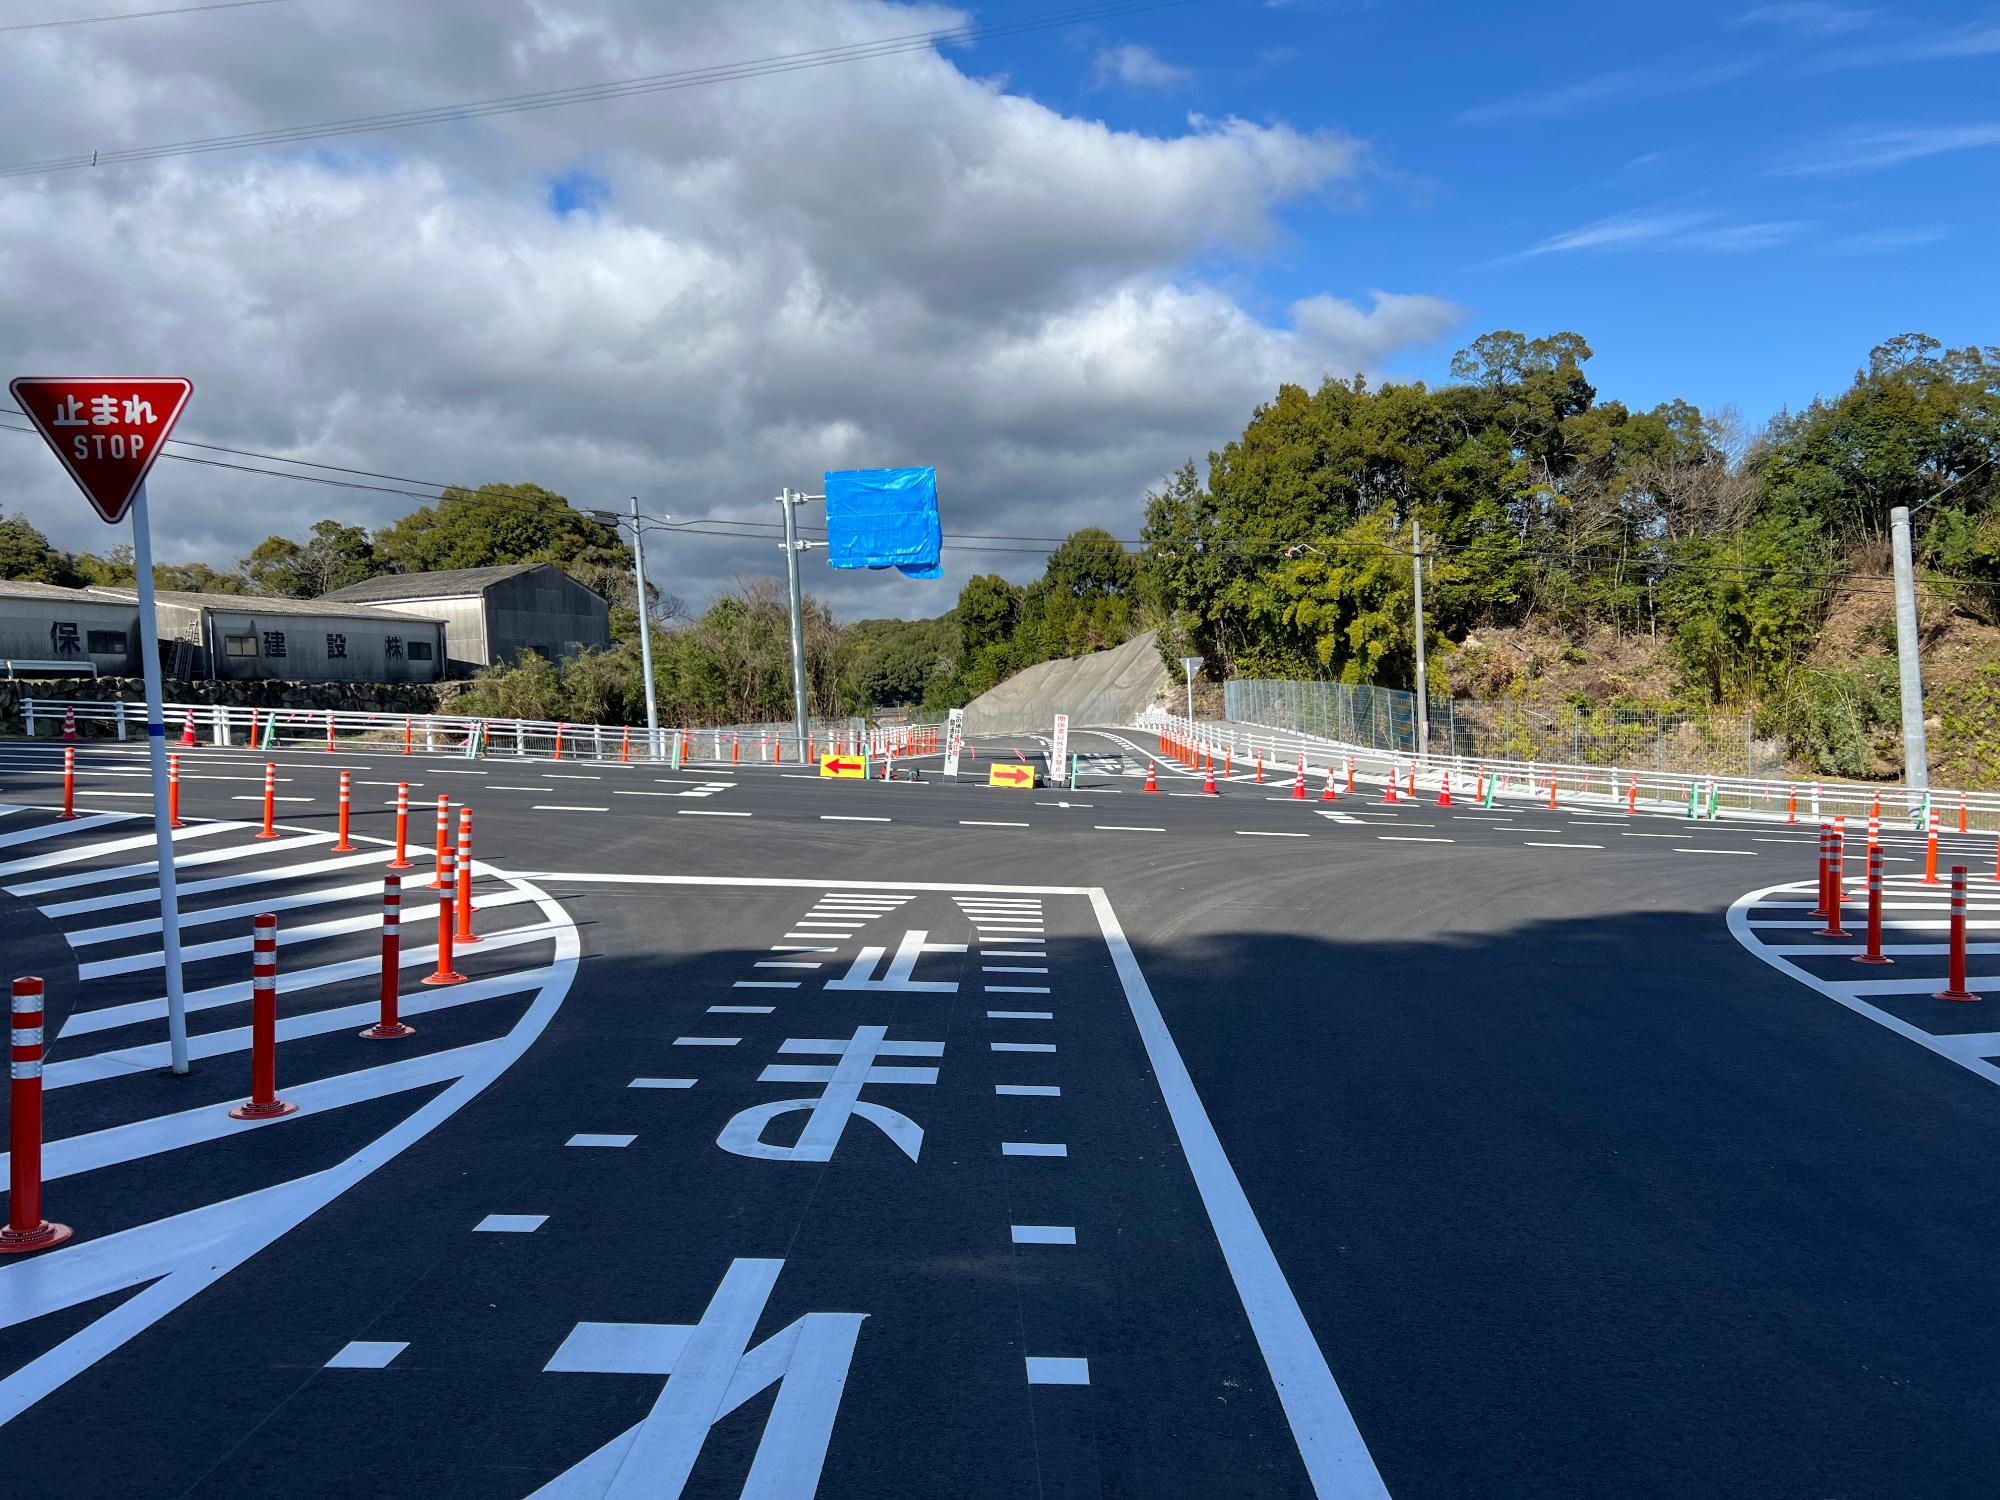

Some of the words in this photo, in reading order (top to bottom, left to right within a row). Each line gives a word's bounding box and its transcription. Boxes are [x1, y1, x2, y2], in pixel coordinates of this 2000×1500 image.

[52, 393, 158, 426] 止まれ
[73, 434, 145, 460] STOP
[50, 621, 81, 655] 保
